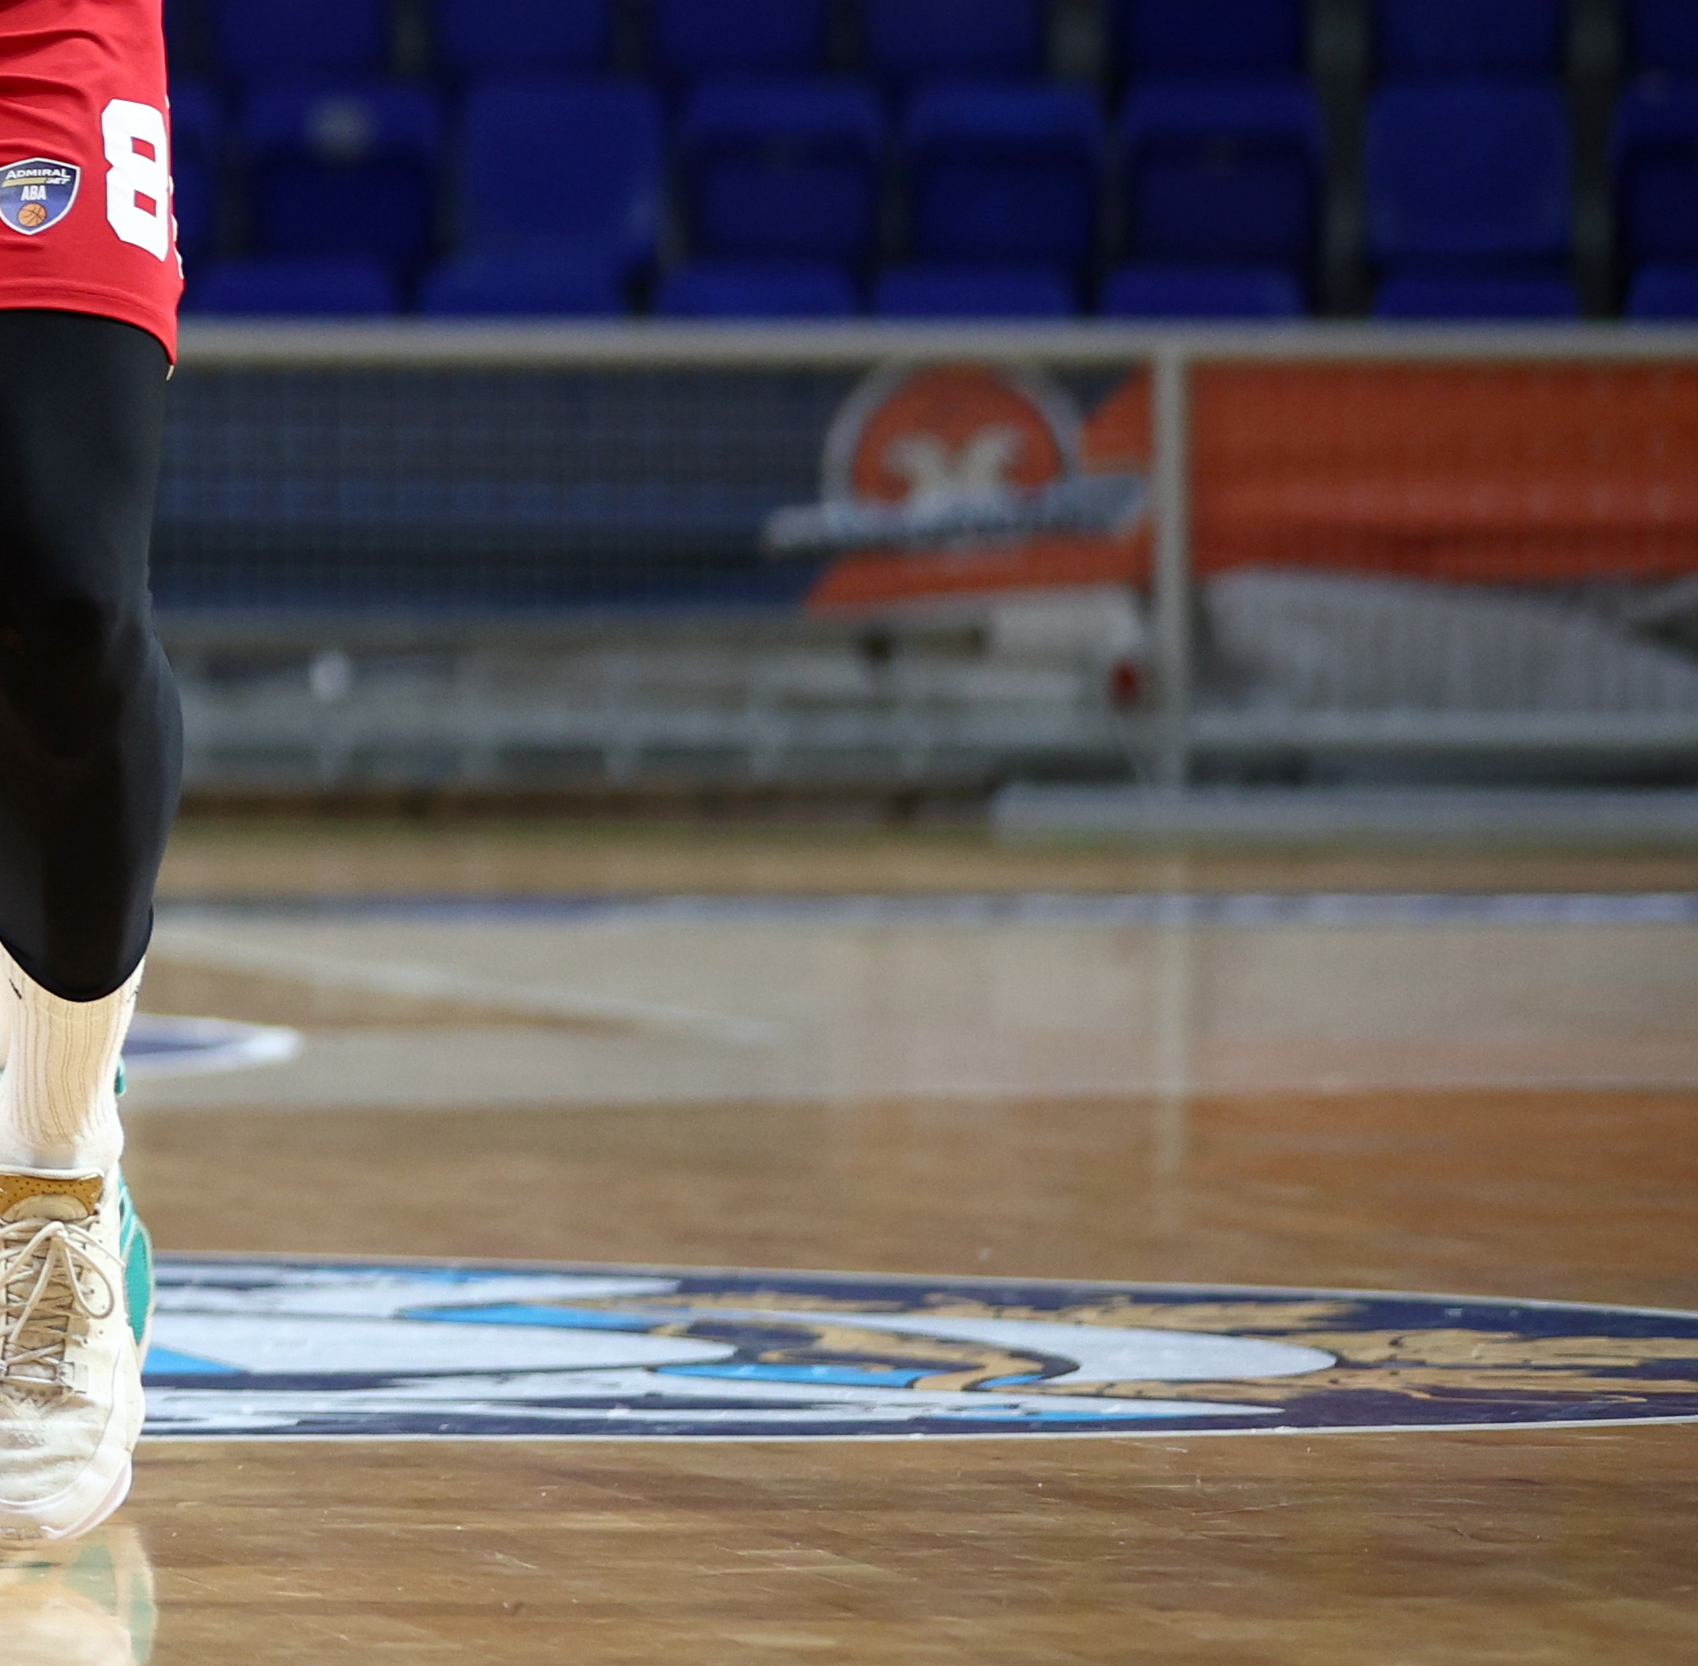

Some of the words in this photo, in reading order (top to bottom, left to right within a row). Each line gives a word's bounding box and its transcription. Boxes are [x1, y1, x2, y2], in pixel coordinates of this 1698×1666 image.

[5, 168, 72, 180] ADMIRAL
[101, 98, 170, 262] 8
[20, 185, 47, 201] ABA
